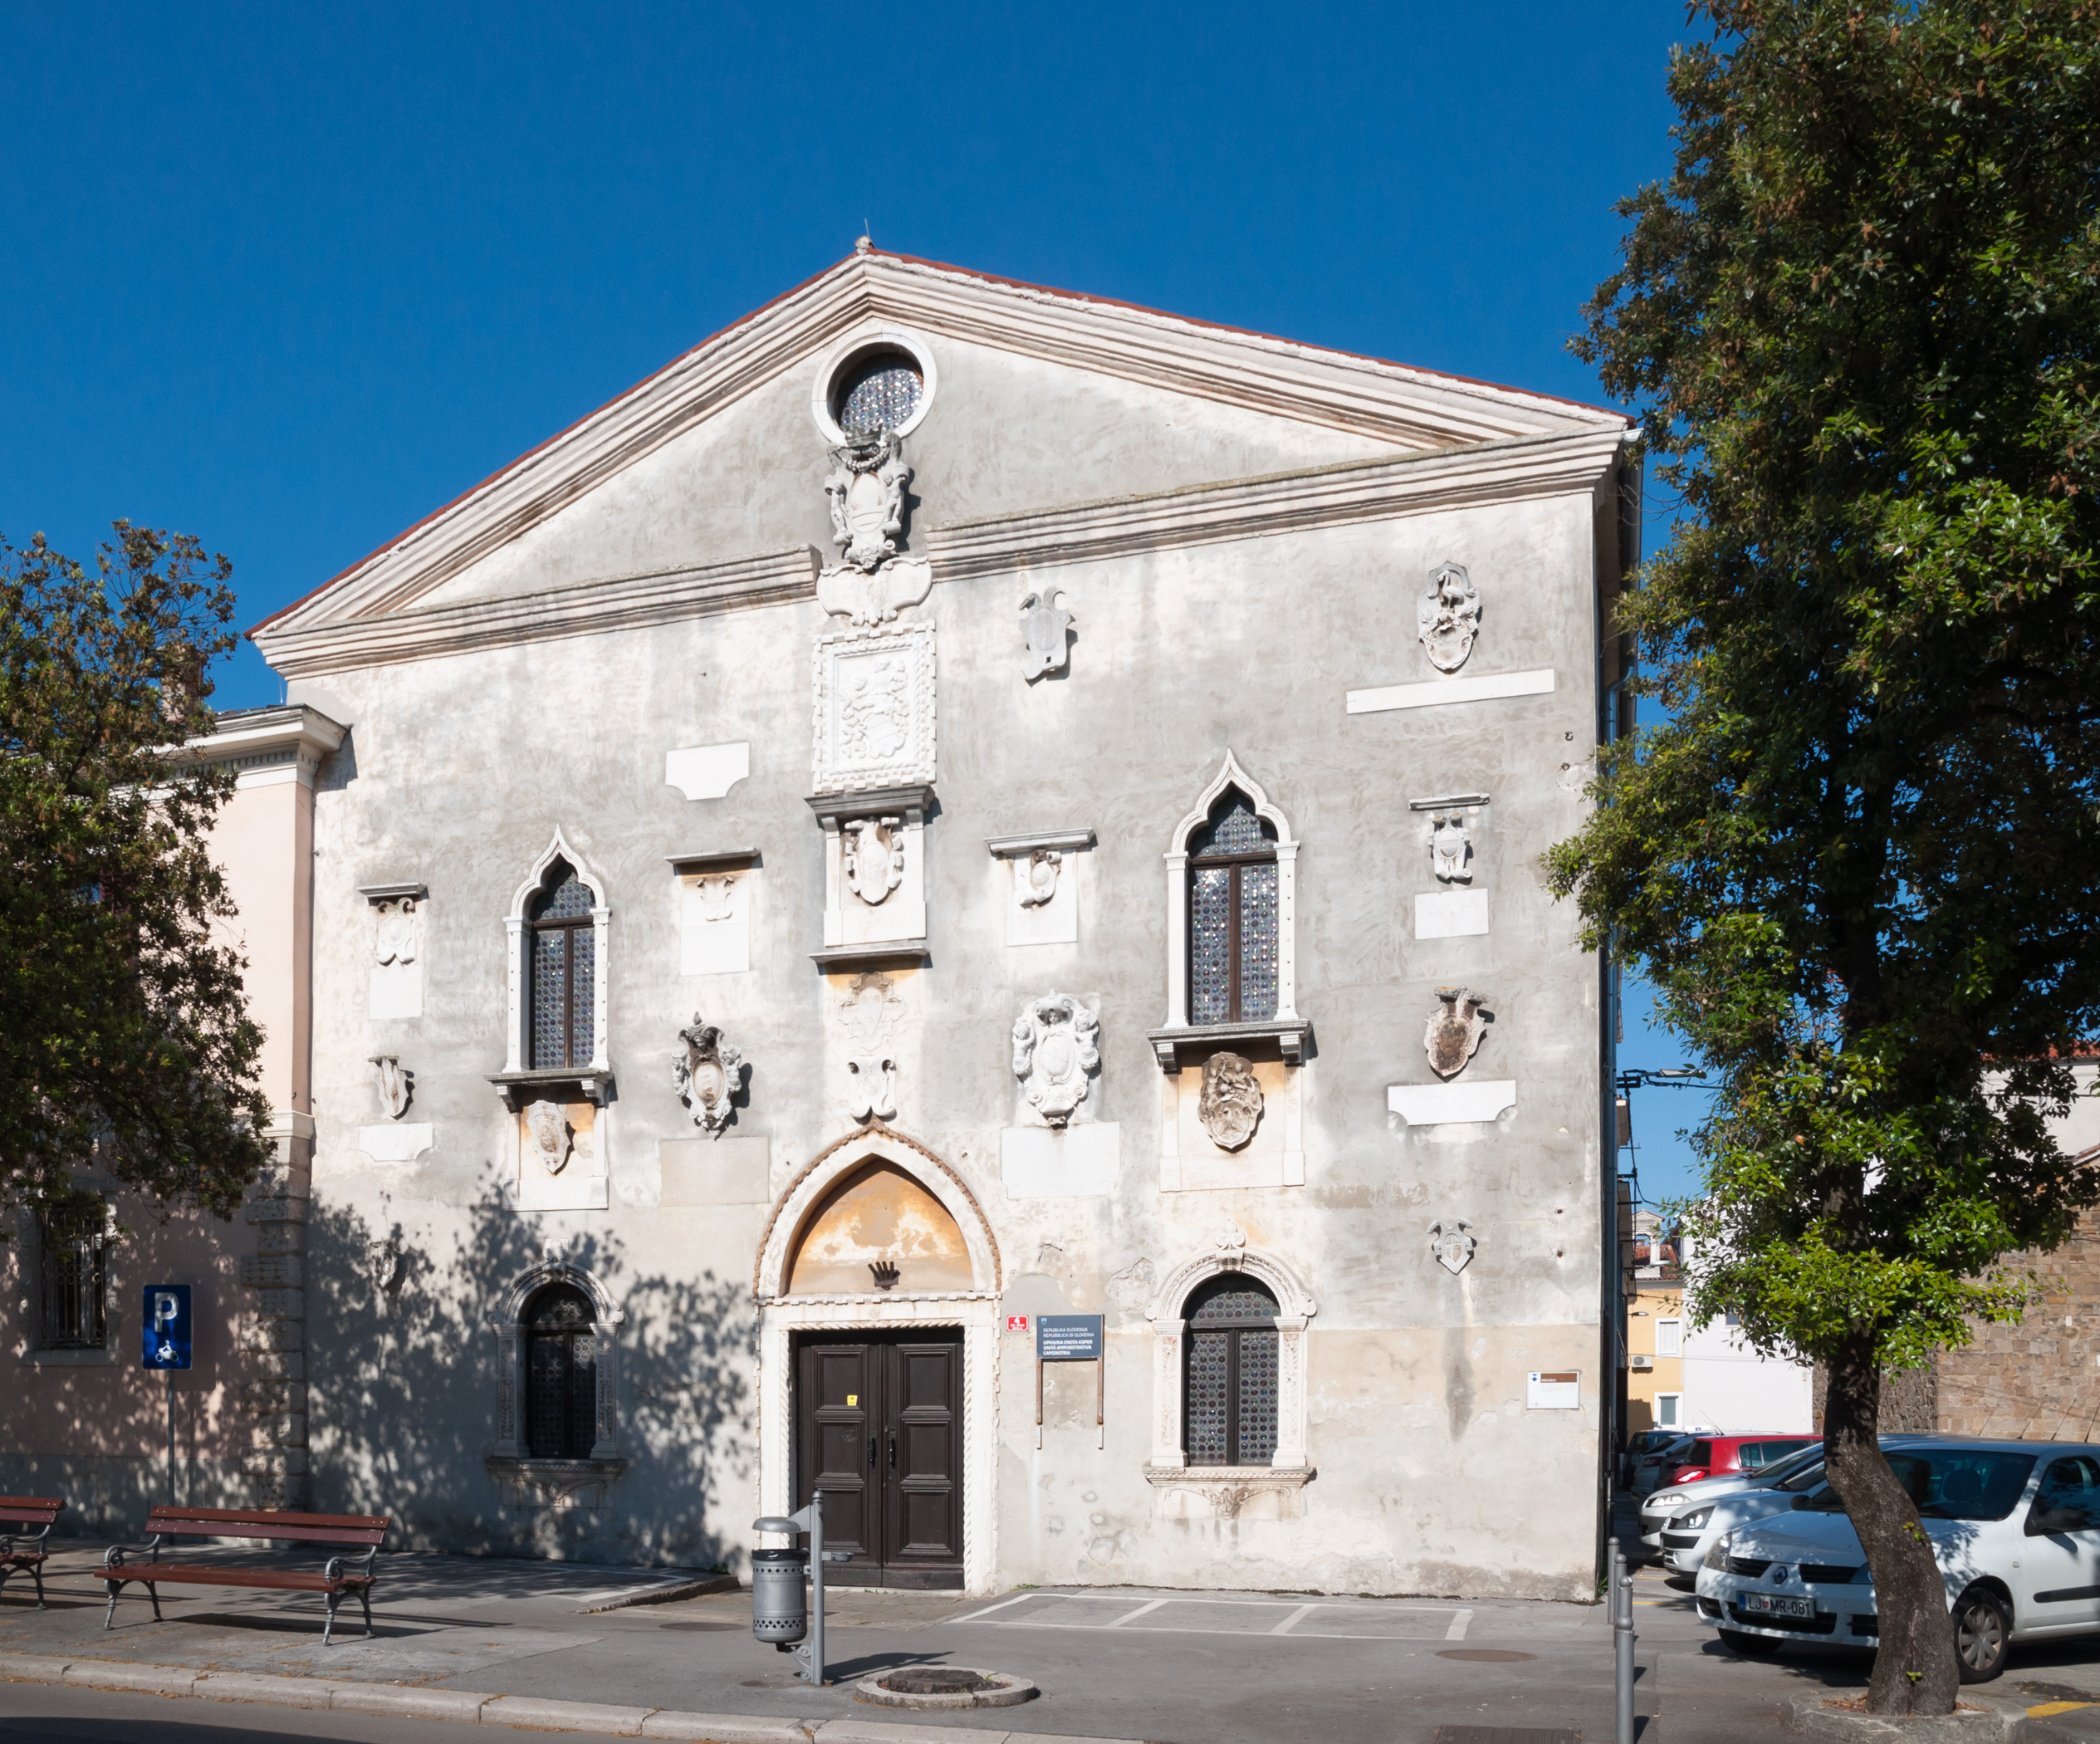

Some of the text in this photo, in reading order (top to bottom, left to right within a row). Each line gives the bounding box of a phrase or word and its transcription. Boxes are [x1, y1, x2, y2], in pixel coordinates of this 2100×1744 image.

[154, 1292, 179, 1332] P
[1014, 1316, 1021, 1325] 4
[1749, 1596, 1810, 1615] LJ MR-081
